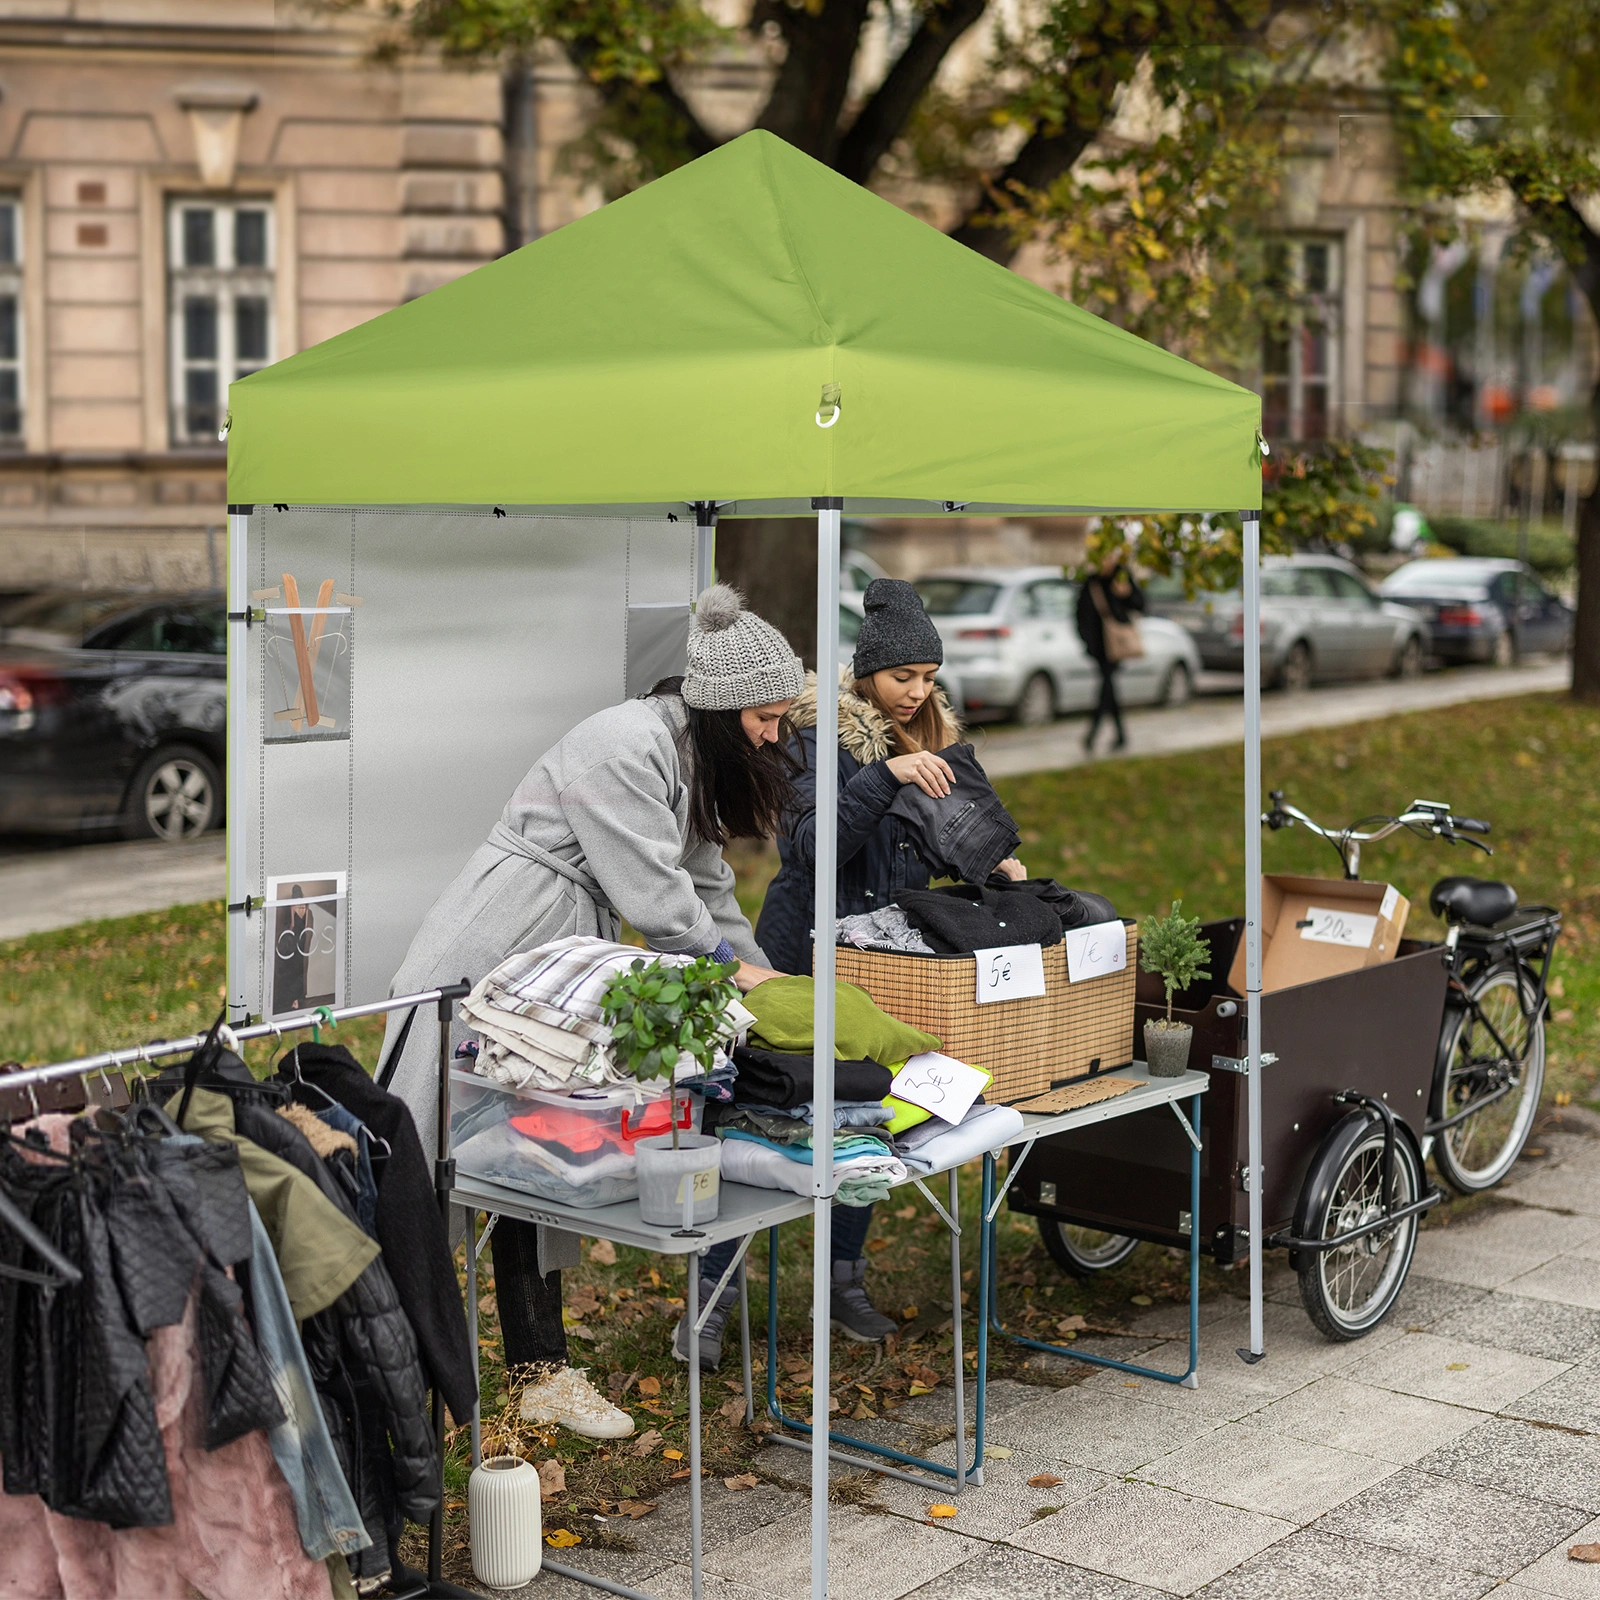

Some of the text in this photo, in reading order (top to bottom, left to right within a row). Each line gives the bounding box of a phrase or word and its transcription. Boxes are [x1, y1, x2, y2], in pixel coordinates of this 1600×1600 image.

[275, 925, 335, 960] COS
[1079, 931, 1103, 968] 7€
[988, 954, 1012, 988] 5€
[904, 1067, 954, 1104] 3€
